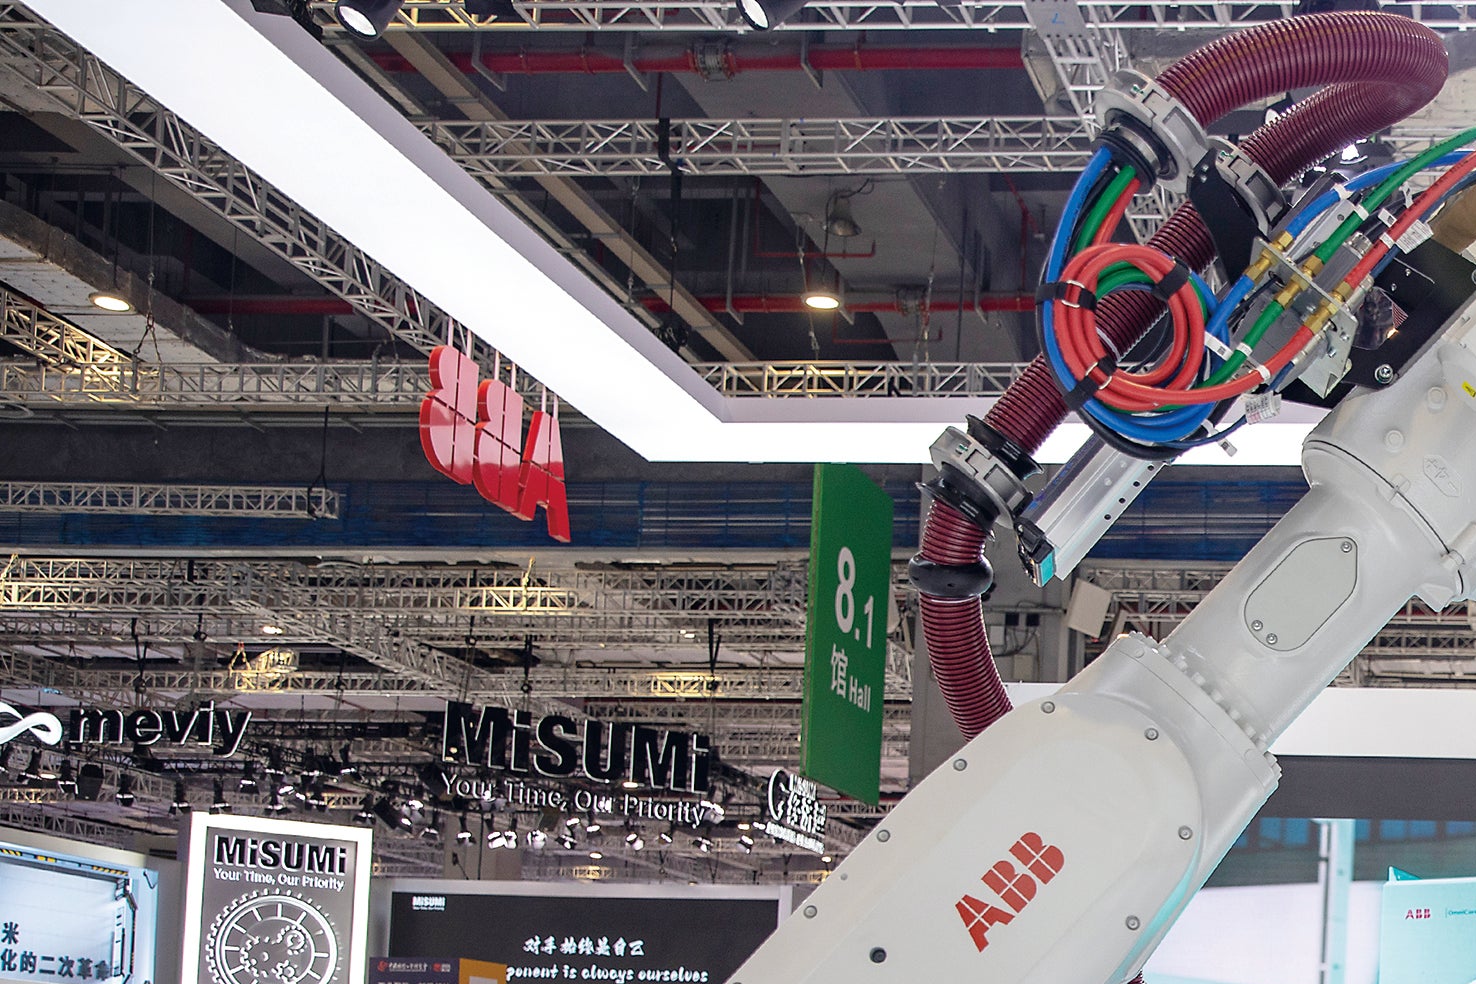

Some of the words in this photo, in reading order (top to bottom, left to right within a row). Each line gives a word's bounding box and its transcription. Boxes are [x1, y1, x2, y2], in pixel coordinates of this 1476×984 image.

[835, 547, 874, 648] 8.1
[831, 643, 848, 699] 馆
[849, 675, 872, 713] Hall
[69, 701, 252, 759] meviy
[441, 772, 497, 802] Your
[624, 794, 705, 829] Priority
[213, 867, 242, 881] Your
[243, 870, 276, 886] Time,
[277, 874, 300, 886] Our
[302, 876, 345, 892] Priority
[953, 831, 1064, 952] ABB
[1, 921, 19, 945] 米
[1405, 909, 1431, 919] ABB
[562, 964, 577, 979] is
[581, 964, 634, 984] always
[637, 966, 709, 982] ourselves
